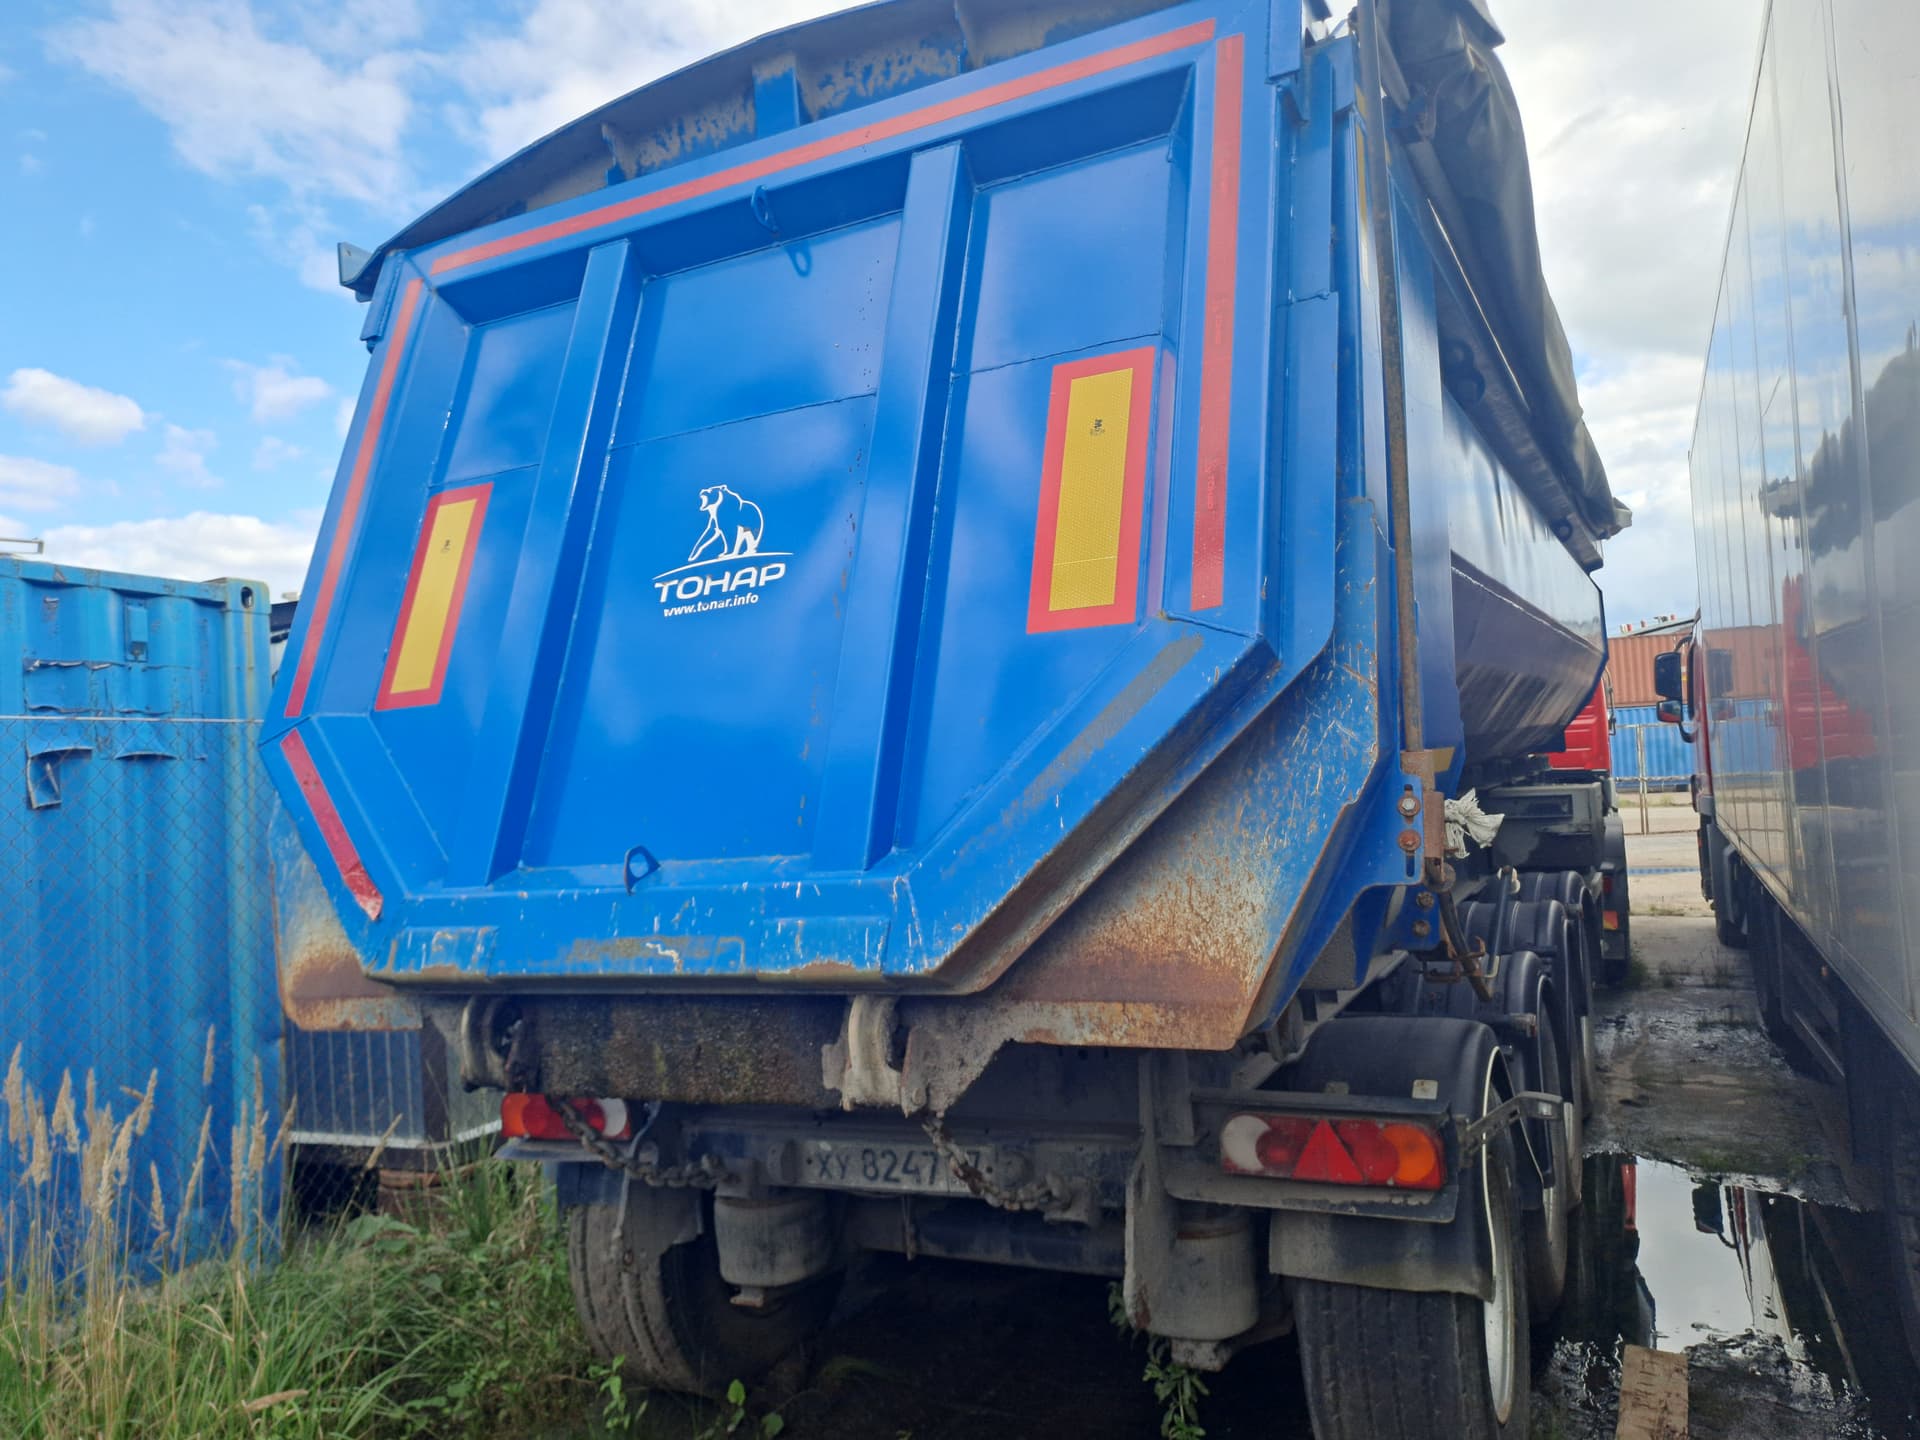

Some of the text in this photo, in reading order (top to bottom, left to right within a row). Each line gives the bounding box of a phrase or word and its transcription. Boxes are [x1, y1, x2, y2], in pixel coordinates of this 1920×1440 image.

[654, 563, 786, 603] ТОНАР
[664, 593, 759, 617] www.tonar.info
[861, 1148, 939, 1185] 8247
